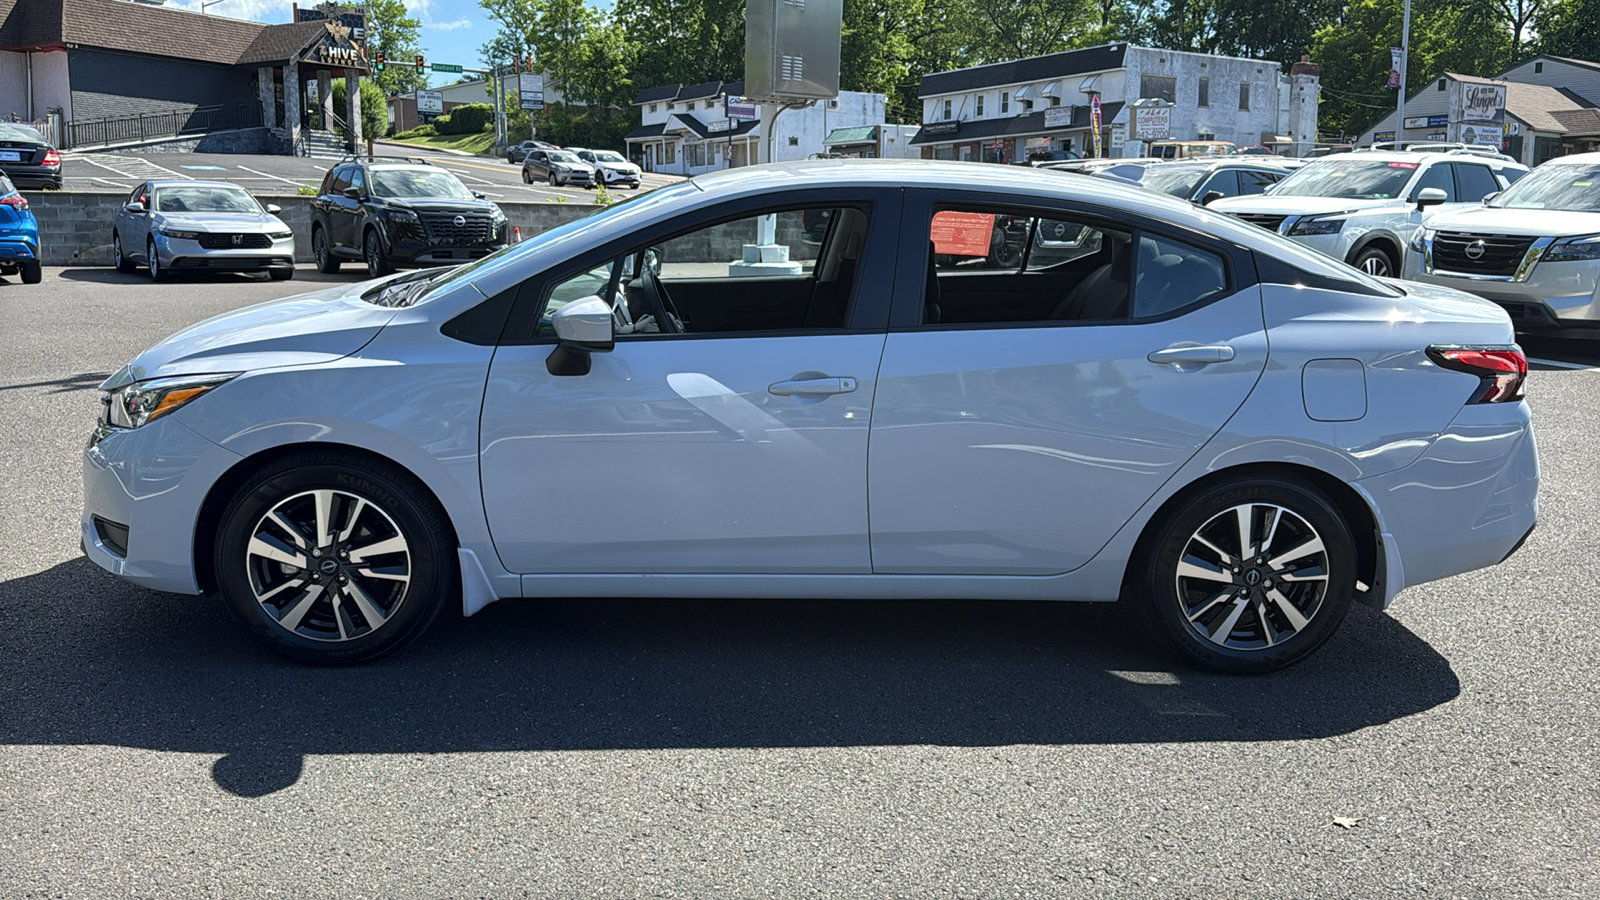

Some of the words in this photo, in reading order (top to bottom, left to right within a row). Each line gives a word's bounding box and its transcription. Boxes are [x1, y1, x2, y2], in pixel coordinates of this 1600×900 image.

[328, 46, 358, 60] HIVE
[320, 56, 358, 67] LOUNGE
[1464, 87, 1503, 114] Langel's
[1137, 116, 1168, 124] COMPUTERS
[1136, 130, 1169, 139] 942-9700
[337, 473, 398, 508] KUMHO
